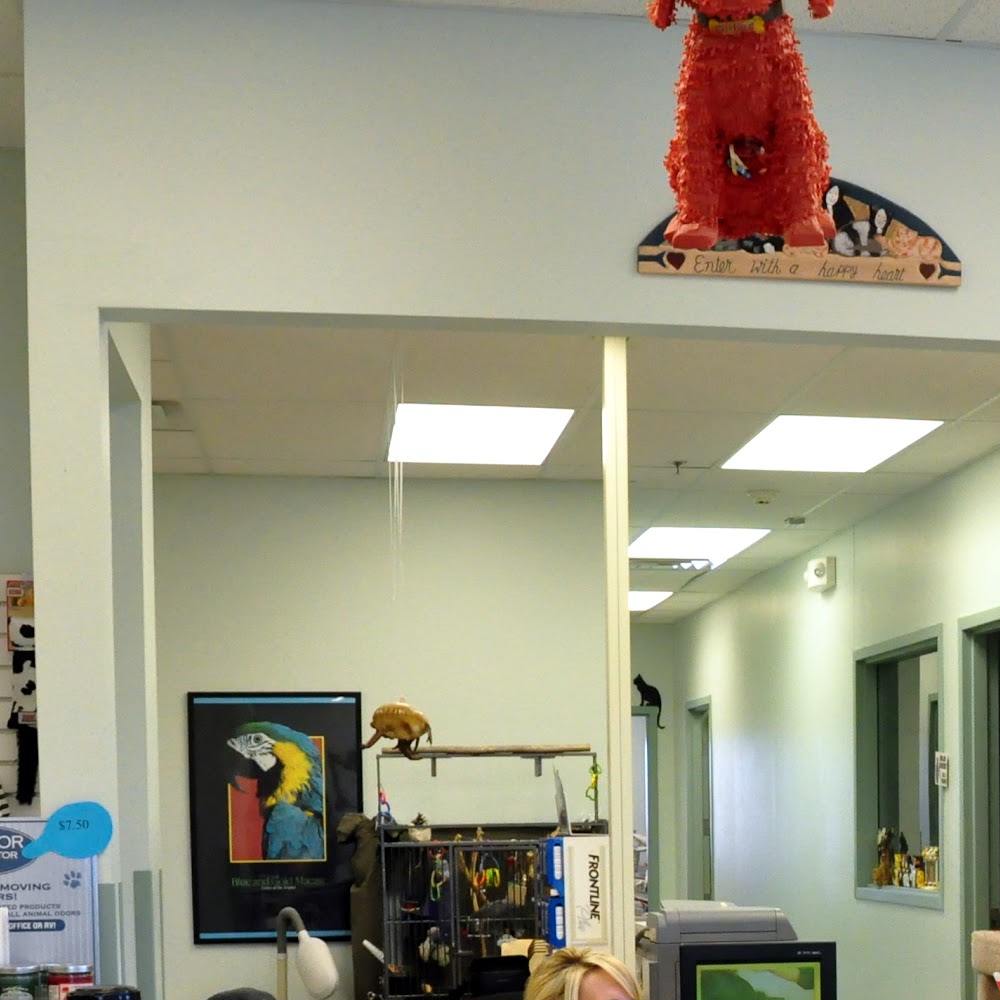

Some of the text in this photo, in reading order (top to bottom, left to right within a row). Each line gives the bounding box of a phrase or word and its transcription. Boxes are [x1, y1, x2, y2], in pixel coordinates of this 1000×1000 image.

[693, 255, 905, 281] Enter with a happy heart
[58, 819, 90, 830] $7.50
[588, 854, 601, 920] FRONTLINE
